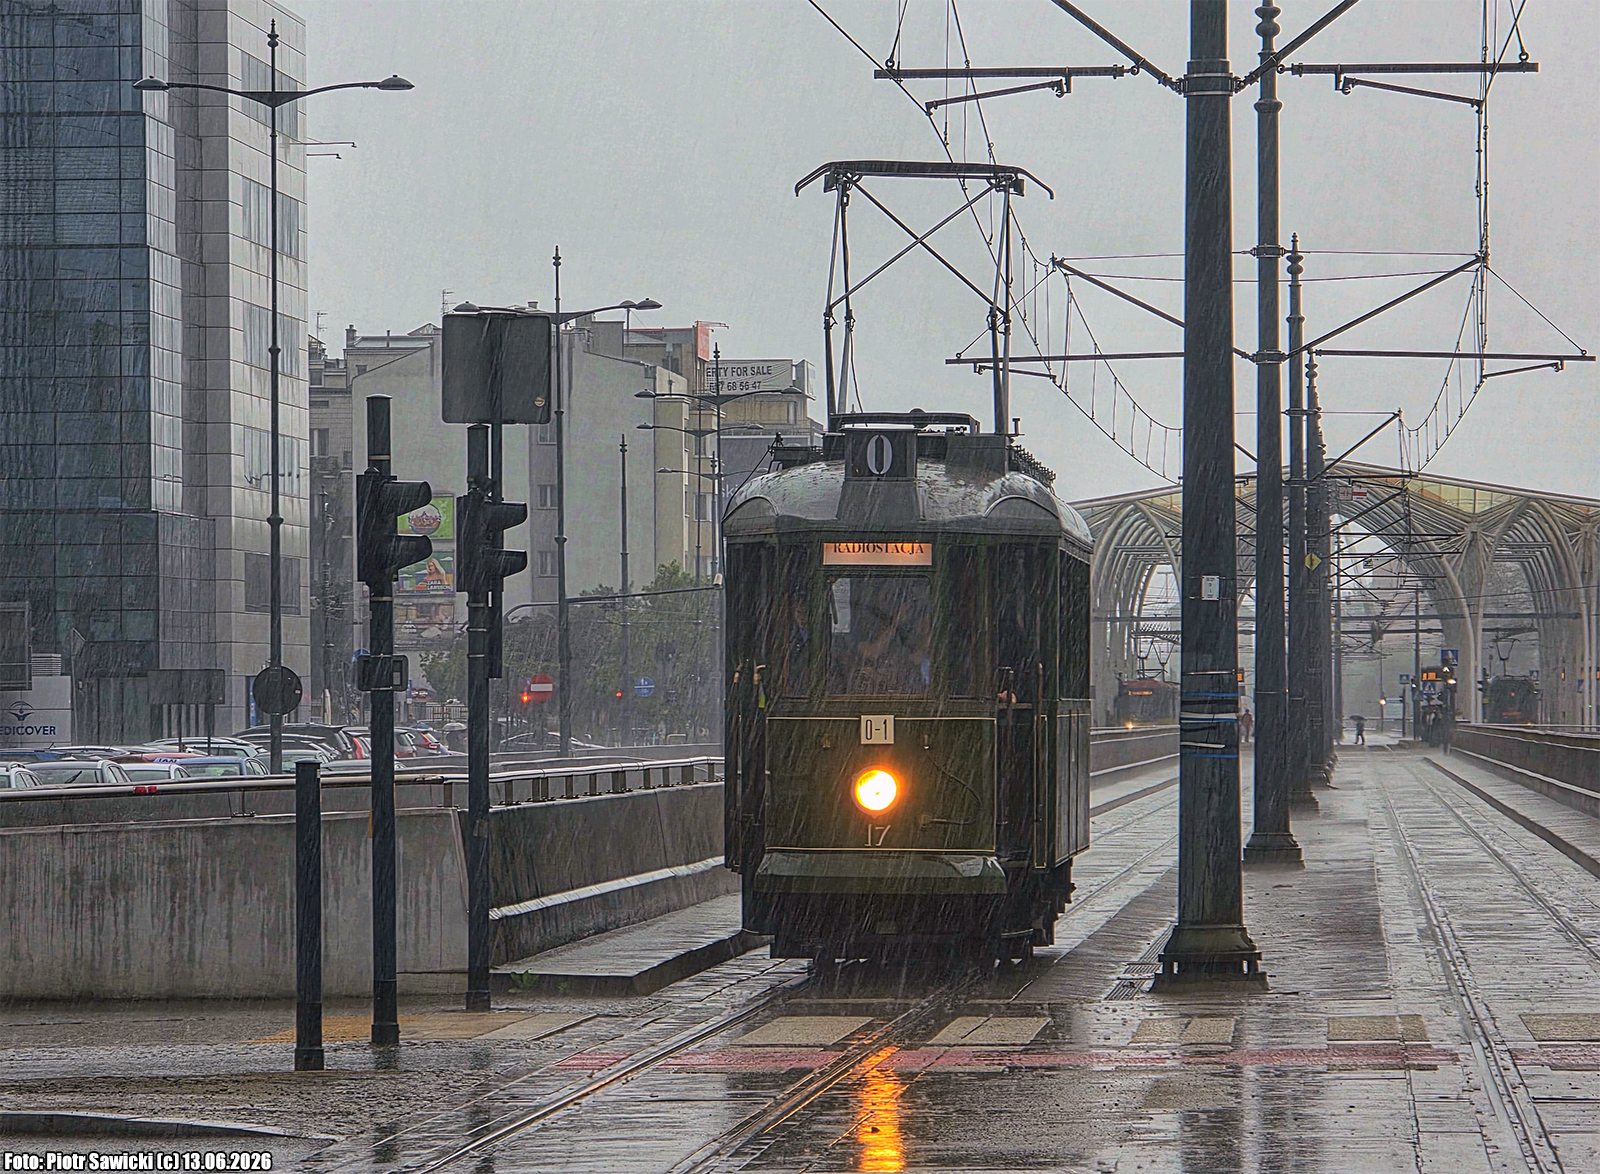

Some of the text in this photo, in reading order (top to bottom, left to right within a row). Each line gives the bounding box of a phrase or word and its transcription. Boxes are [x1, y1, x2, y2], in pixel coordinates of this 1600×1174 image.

[731, 366, 748, 377] FOR
[750, 365, 773, 376] SALE
[727, 381, 737, 391] 68
[866, 434, 894, 475] 0
[865, 718, 888, 741] 0-1
[864, 823, 891, 847] 17
